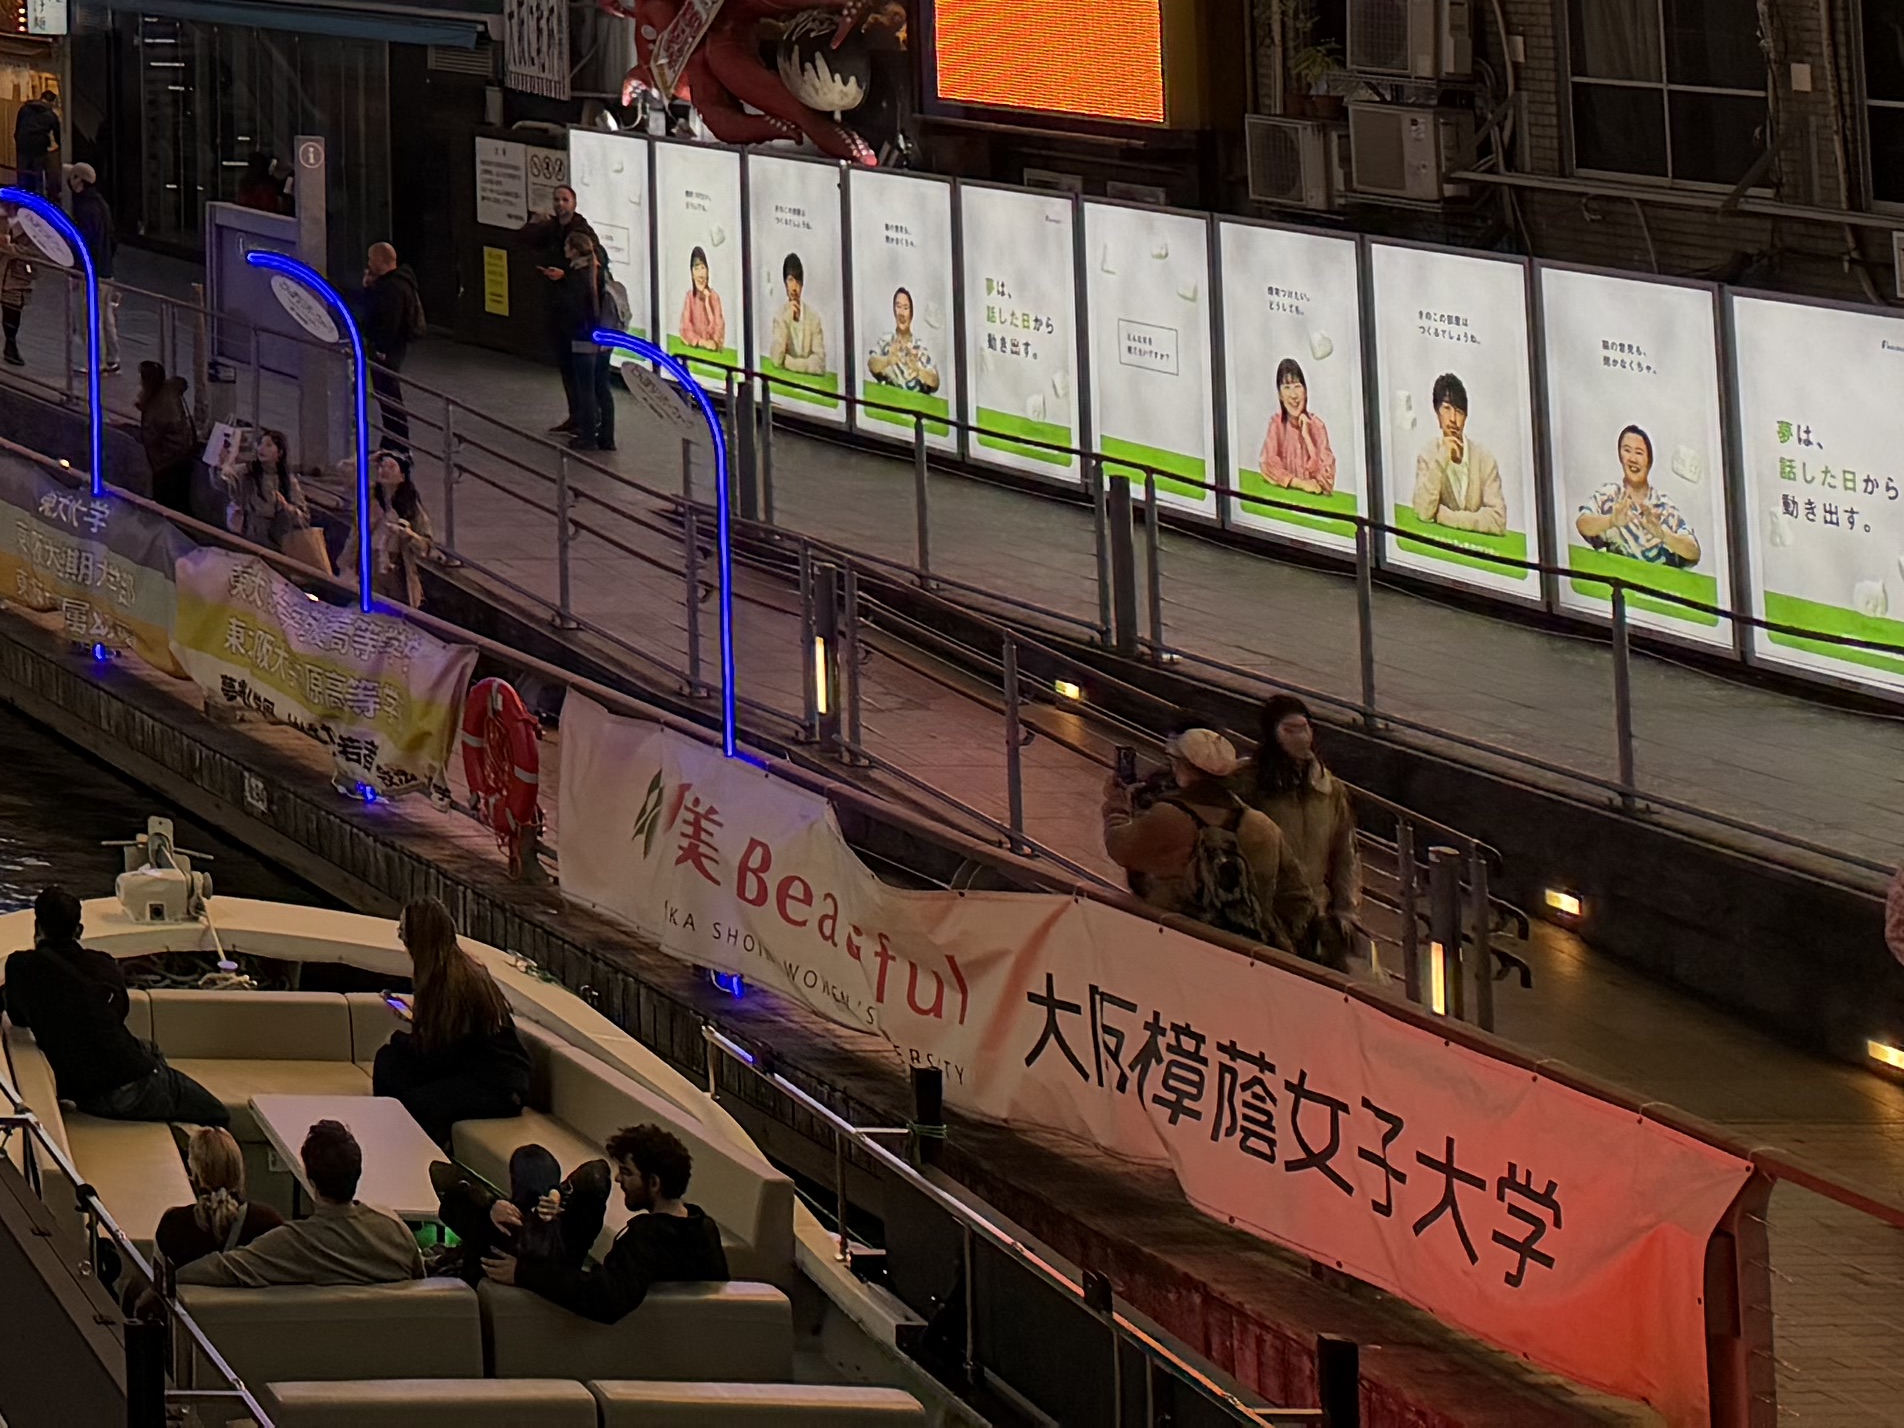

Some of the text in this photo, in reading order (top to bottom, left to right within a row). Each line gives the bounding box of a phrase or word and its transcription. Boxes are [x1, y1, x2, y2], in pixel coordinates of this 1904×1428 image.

[986, 304, 1055, 335] 話した日から
[987, 332, 1039, 361] 動き出す。
[1776, 420, 1824, 450] 夢は、
[1779, 456, 1900, 502] 話した日から
[1780, 493, 1872, 534] 動き出す。
